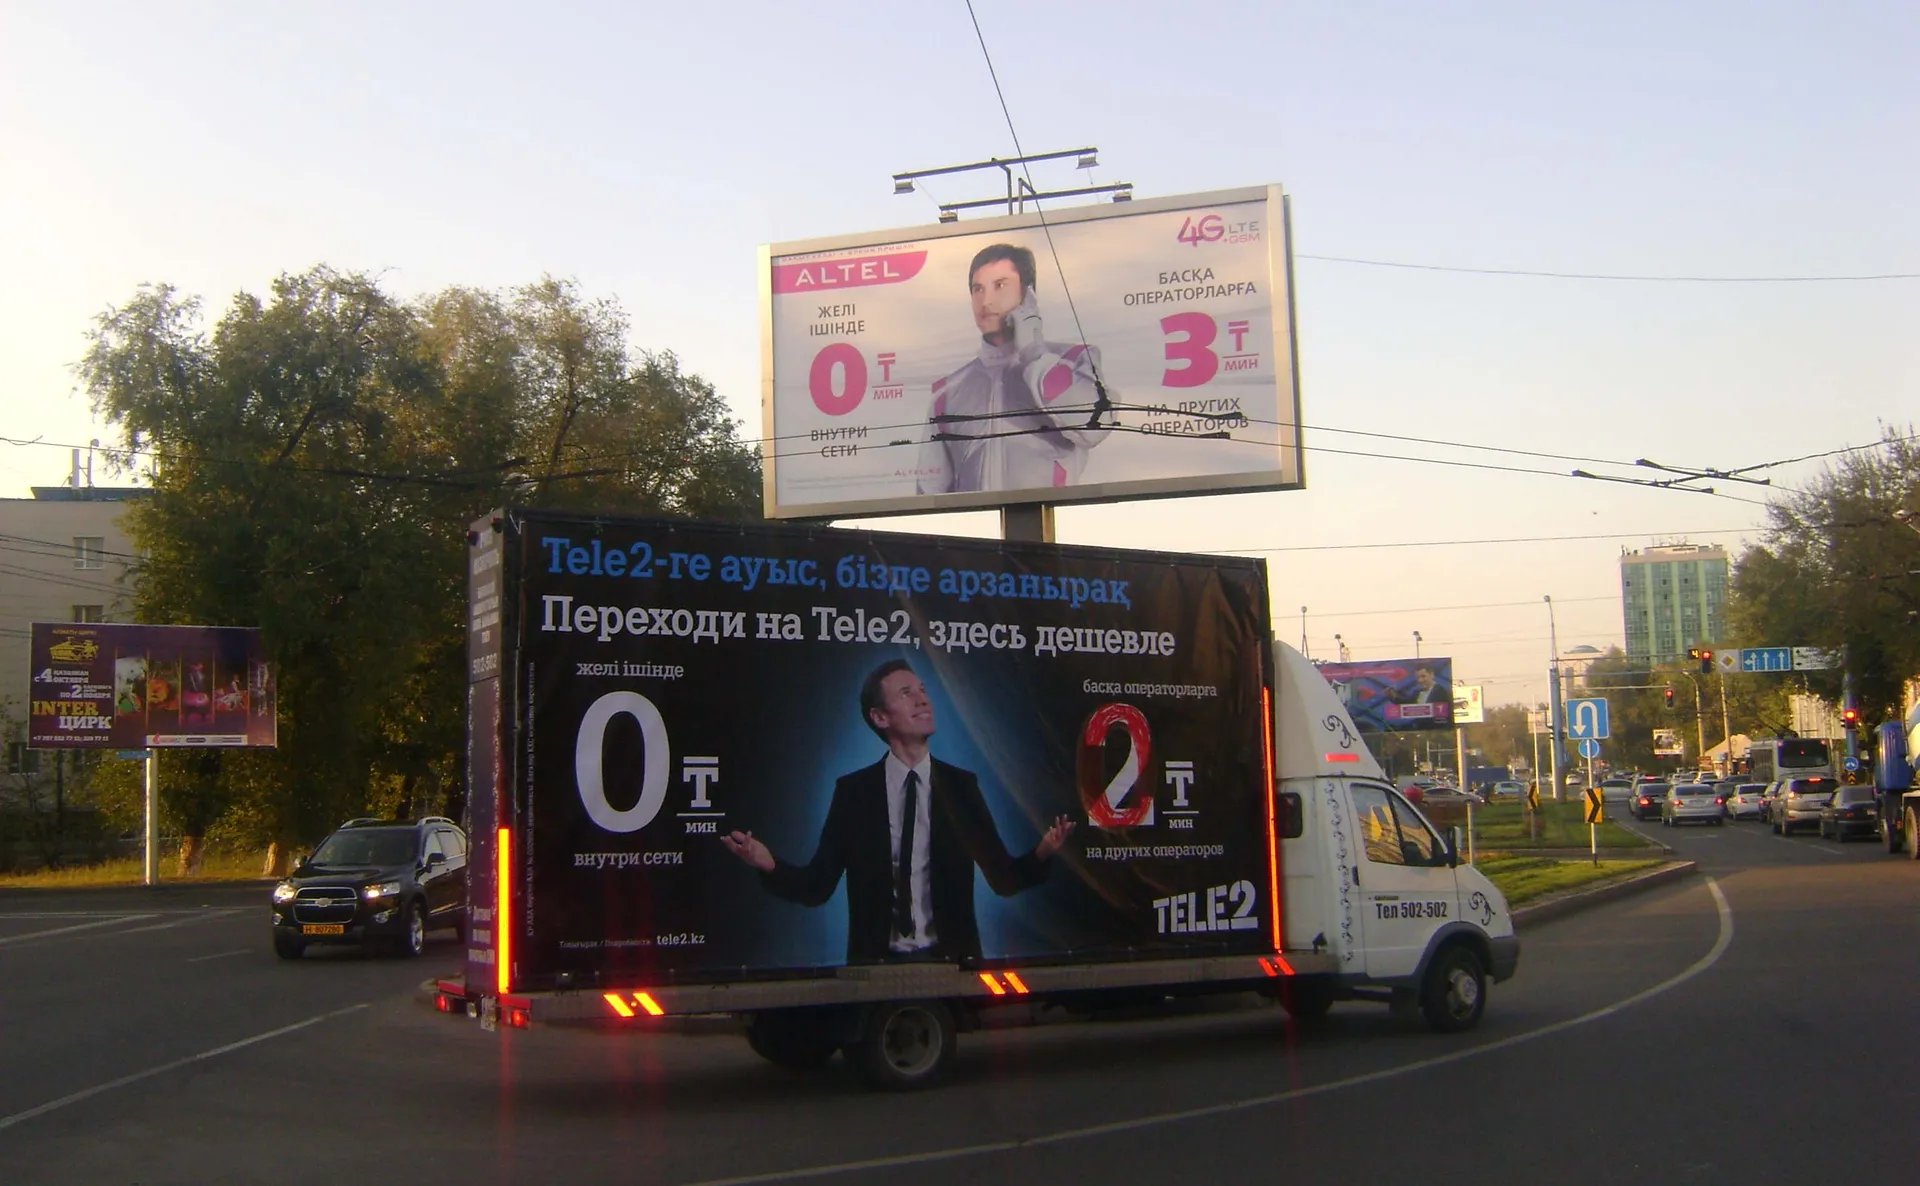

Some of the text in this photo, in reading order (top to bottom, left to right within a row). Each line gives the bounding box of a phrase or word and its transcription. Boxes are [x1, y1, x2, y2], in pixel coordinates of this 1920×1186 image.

[1176, 215, 1225, 247] 4G
[1228, 221, 1259, 234] LTE
[795, 261, 900, 286] ALTEL
[1159, 267, 1215, 285] БАСҚА
[1123, 281, 1257, 306] ОПЕРАТОРЛАРҒА
[818, 303, 856, 319] ЖЕЛІ
[810, 320, 865, 336] ІШІНДЕ
[1160, 311, 1219, 388] 3
[1224, 358, 1258, 372] МИН
[808, 342, 868, 416] 0
[873, 388, 903, 400] МИН
[1177, 397, 1241, 417] ДРУГИХ
[811, 426, 868, 441] ВНУТРИ
[1140, 416, 1249, 435] ОПЕРАТОРОВ
[821, 444, 857, 458] СЕТИ
[542, 537, 711, 581] Tele2-ге
[720, 553, 827, 592] ауыс,
[836, 555, 930, 597] бізде
[939, 568, 1131, 610] арзанырақ
[541, 595, 1176, 657] Переходи на Tele2, здесь дешевле
[40, 667, 53, 683] 4
[576, 660, 684, 680] желі ішінде
[53, 676, 89, 684] ОКТРЯ
[1083, 678, 1122, 697] басқа
[71, 684, 82, 699] 2
[32, 701, 99, 716] INTER
[59, 716, 112, 731] ЦИРК
[575, 690, 671, 833] 0
[1084, 703, 1155, 828] 2
[685, 821, 717, 833] мин
[1168, 818, 1193, 829] мин
[574, 851, 684, 869] внутри сети
[1086, 843, 1224, 861] на других операторов
[1153, 879, 1259, 934] TELE2
[1375, 901, 1448, 919] Тел 502-502
[656, 933, 706, 946] tele2.kz
